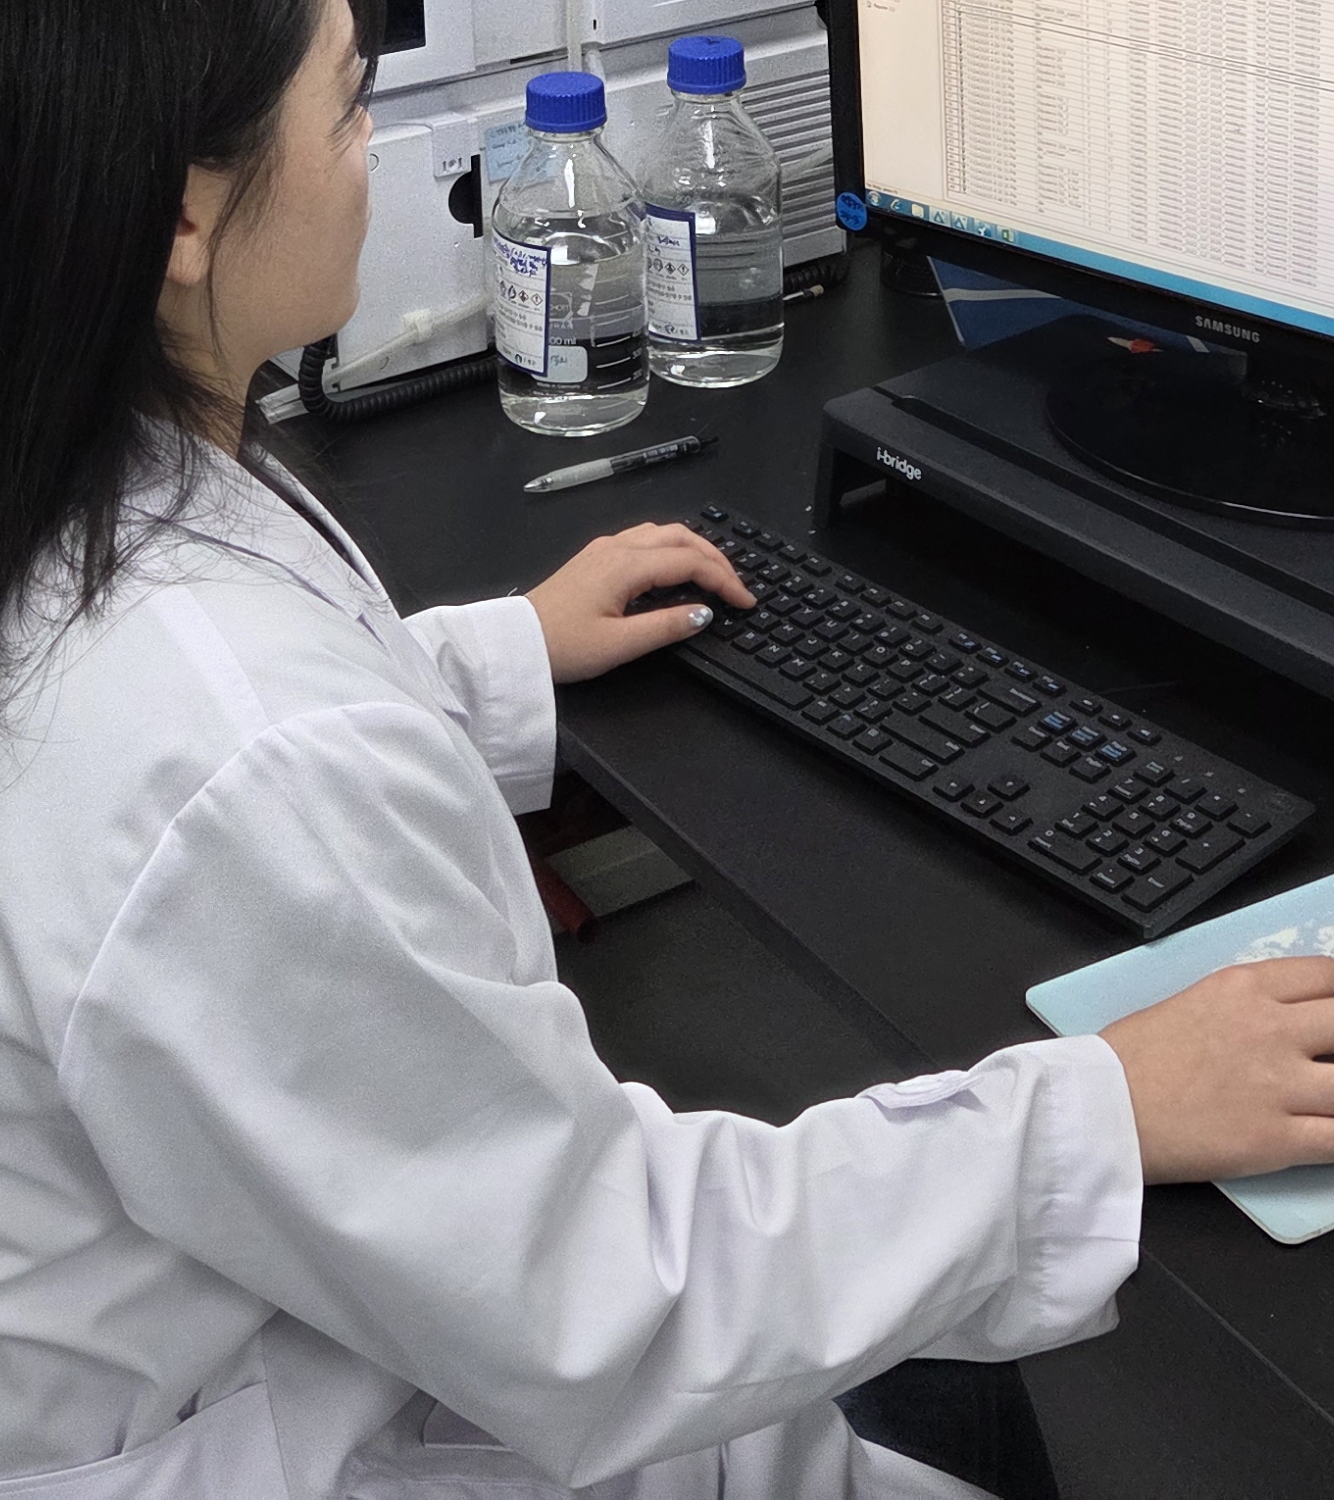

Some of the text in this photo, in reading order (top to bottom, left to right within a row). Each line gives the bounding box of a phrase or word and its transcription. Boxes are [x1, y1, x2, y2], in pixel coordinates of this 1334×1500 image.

[1194, 315, 1260, 343] SAMSUNG
[876, 446, 922, 481] i-bridge
[804, 607, 813, 615] Y
[827, 620, 837, 628] U
[769, 645, 780, 653] N
[876, 646, 886, 654] O
[831, 650, 843, 658] K
[857, 664, 865, 672] L
